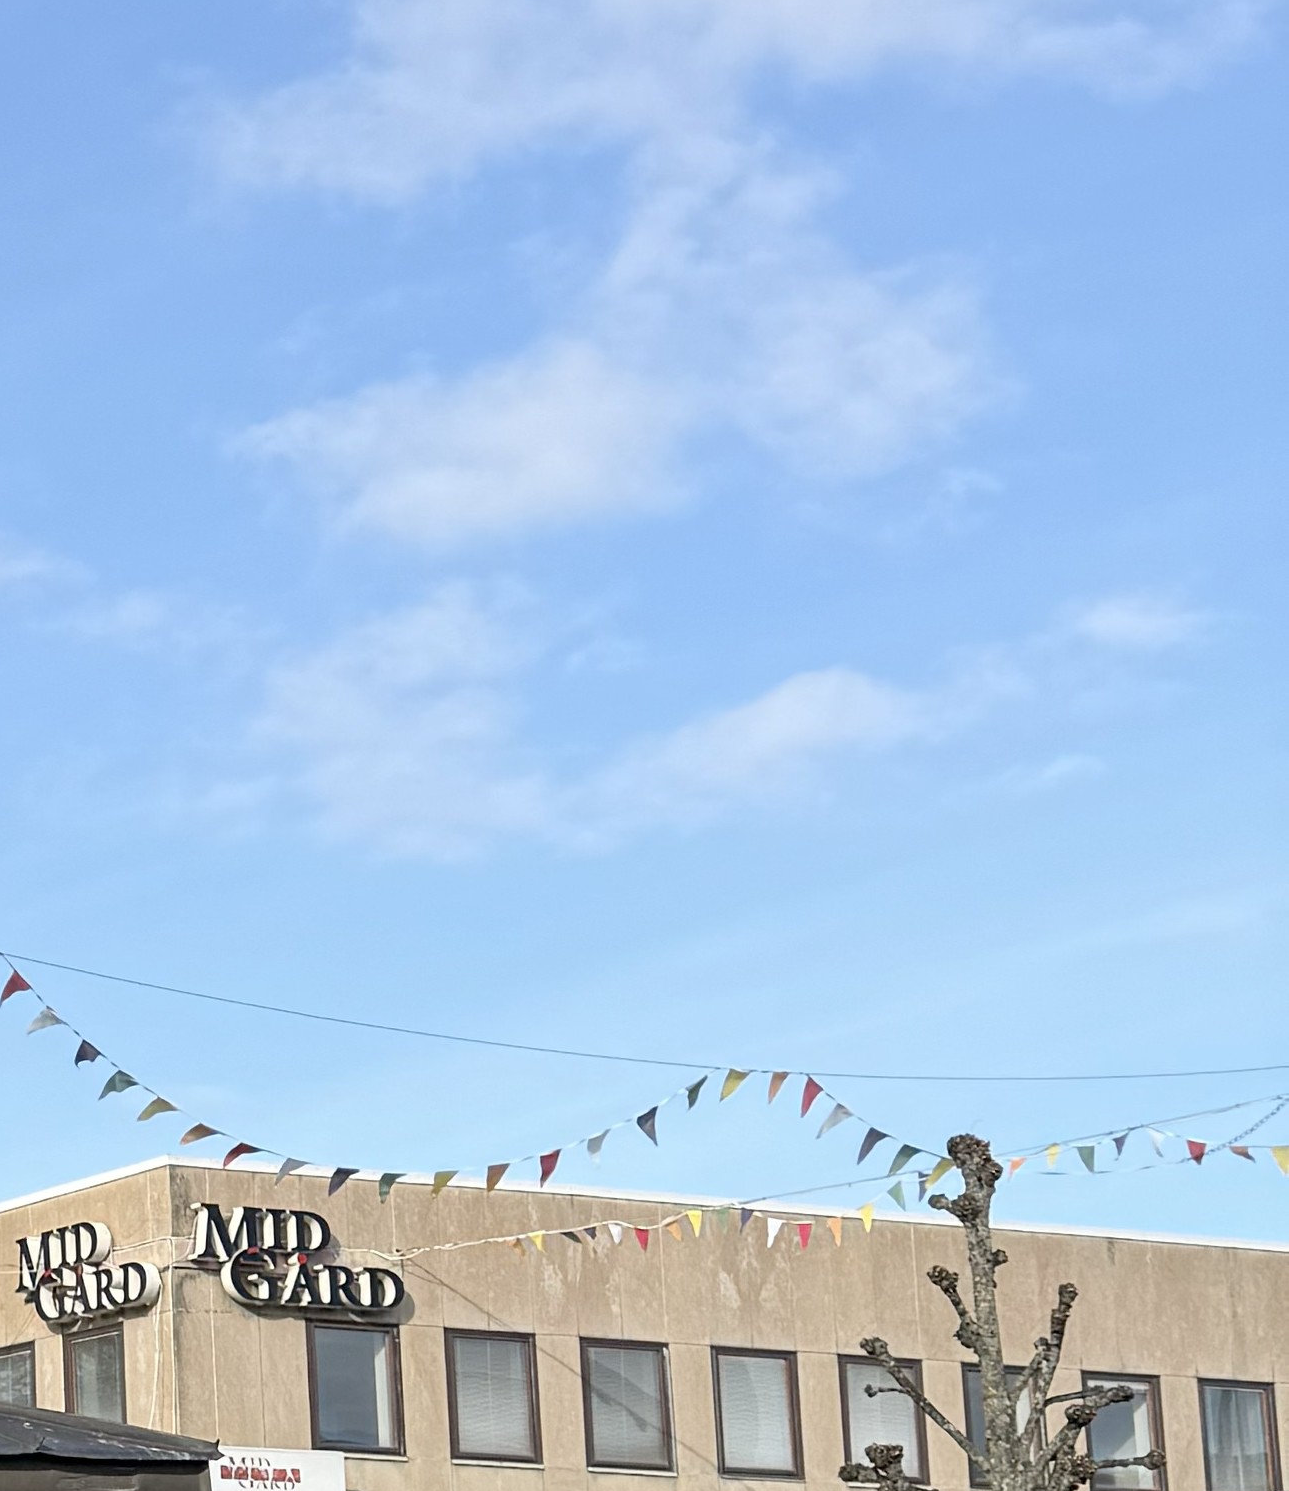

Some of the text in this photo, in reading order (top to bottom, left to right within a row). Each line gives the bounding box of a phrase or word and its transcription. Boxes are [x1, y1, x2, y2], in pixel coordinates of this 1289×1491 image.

[15, 1222, 111, 1293] MID
[187, 1202, 332, 1262] MID
[34, 1262, 160, 1323] GARD
[223, 1246, 406, 1310] GARD
